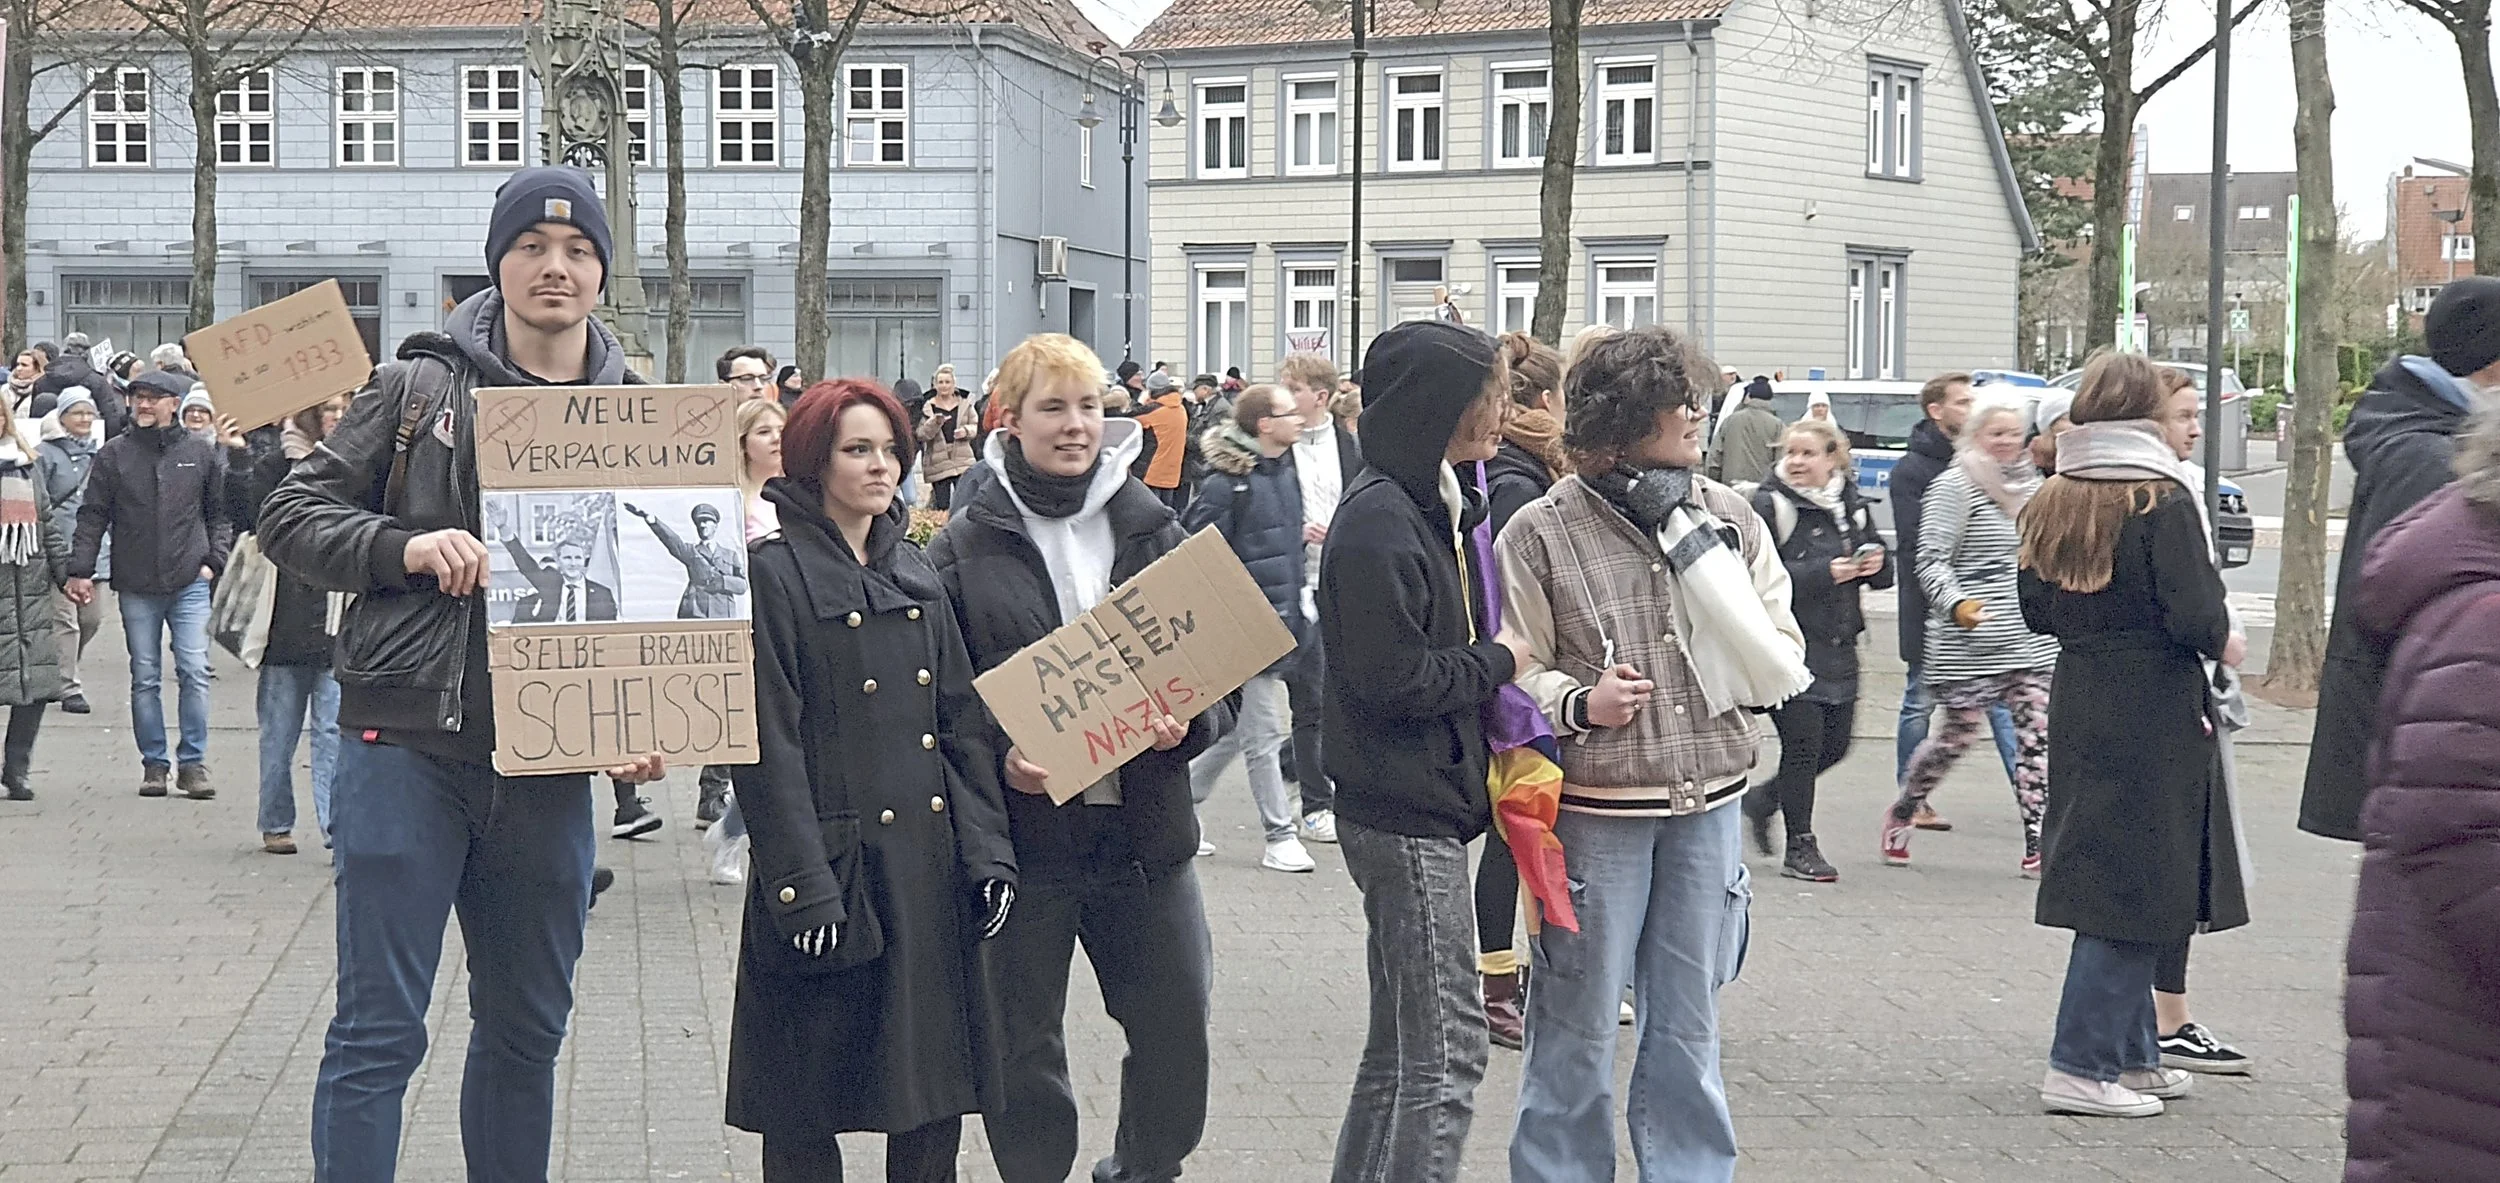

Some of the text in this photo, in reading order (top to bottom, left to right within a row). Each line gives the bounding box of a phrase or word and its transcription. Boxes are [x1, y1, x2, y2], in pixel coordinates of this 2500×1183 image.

[219, 323, 272, 361] AFD
[283, 339, 344, 381] 1933
[564, 396, 658, 424] NEUE
[505, 439, 717, 472] VERPACKUNG
[510, 632, 739, 671] SELBE BRAUNE
[1032, 586, 1159, 694] ALLE
[1040, 610, 1197, 733] HASSEN
[512, 673, 747, 761] SCHEISSE
